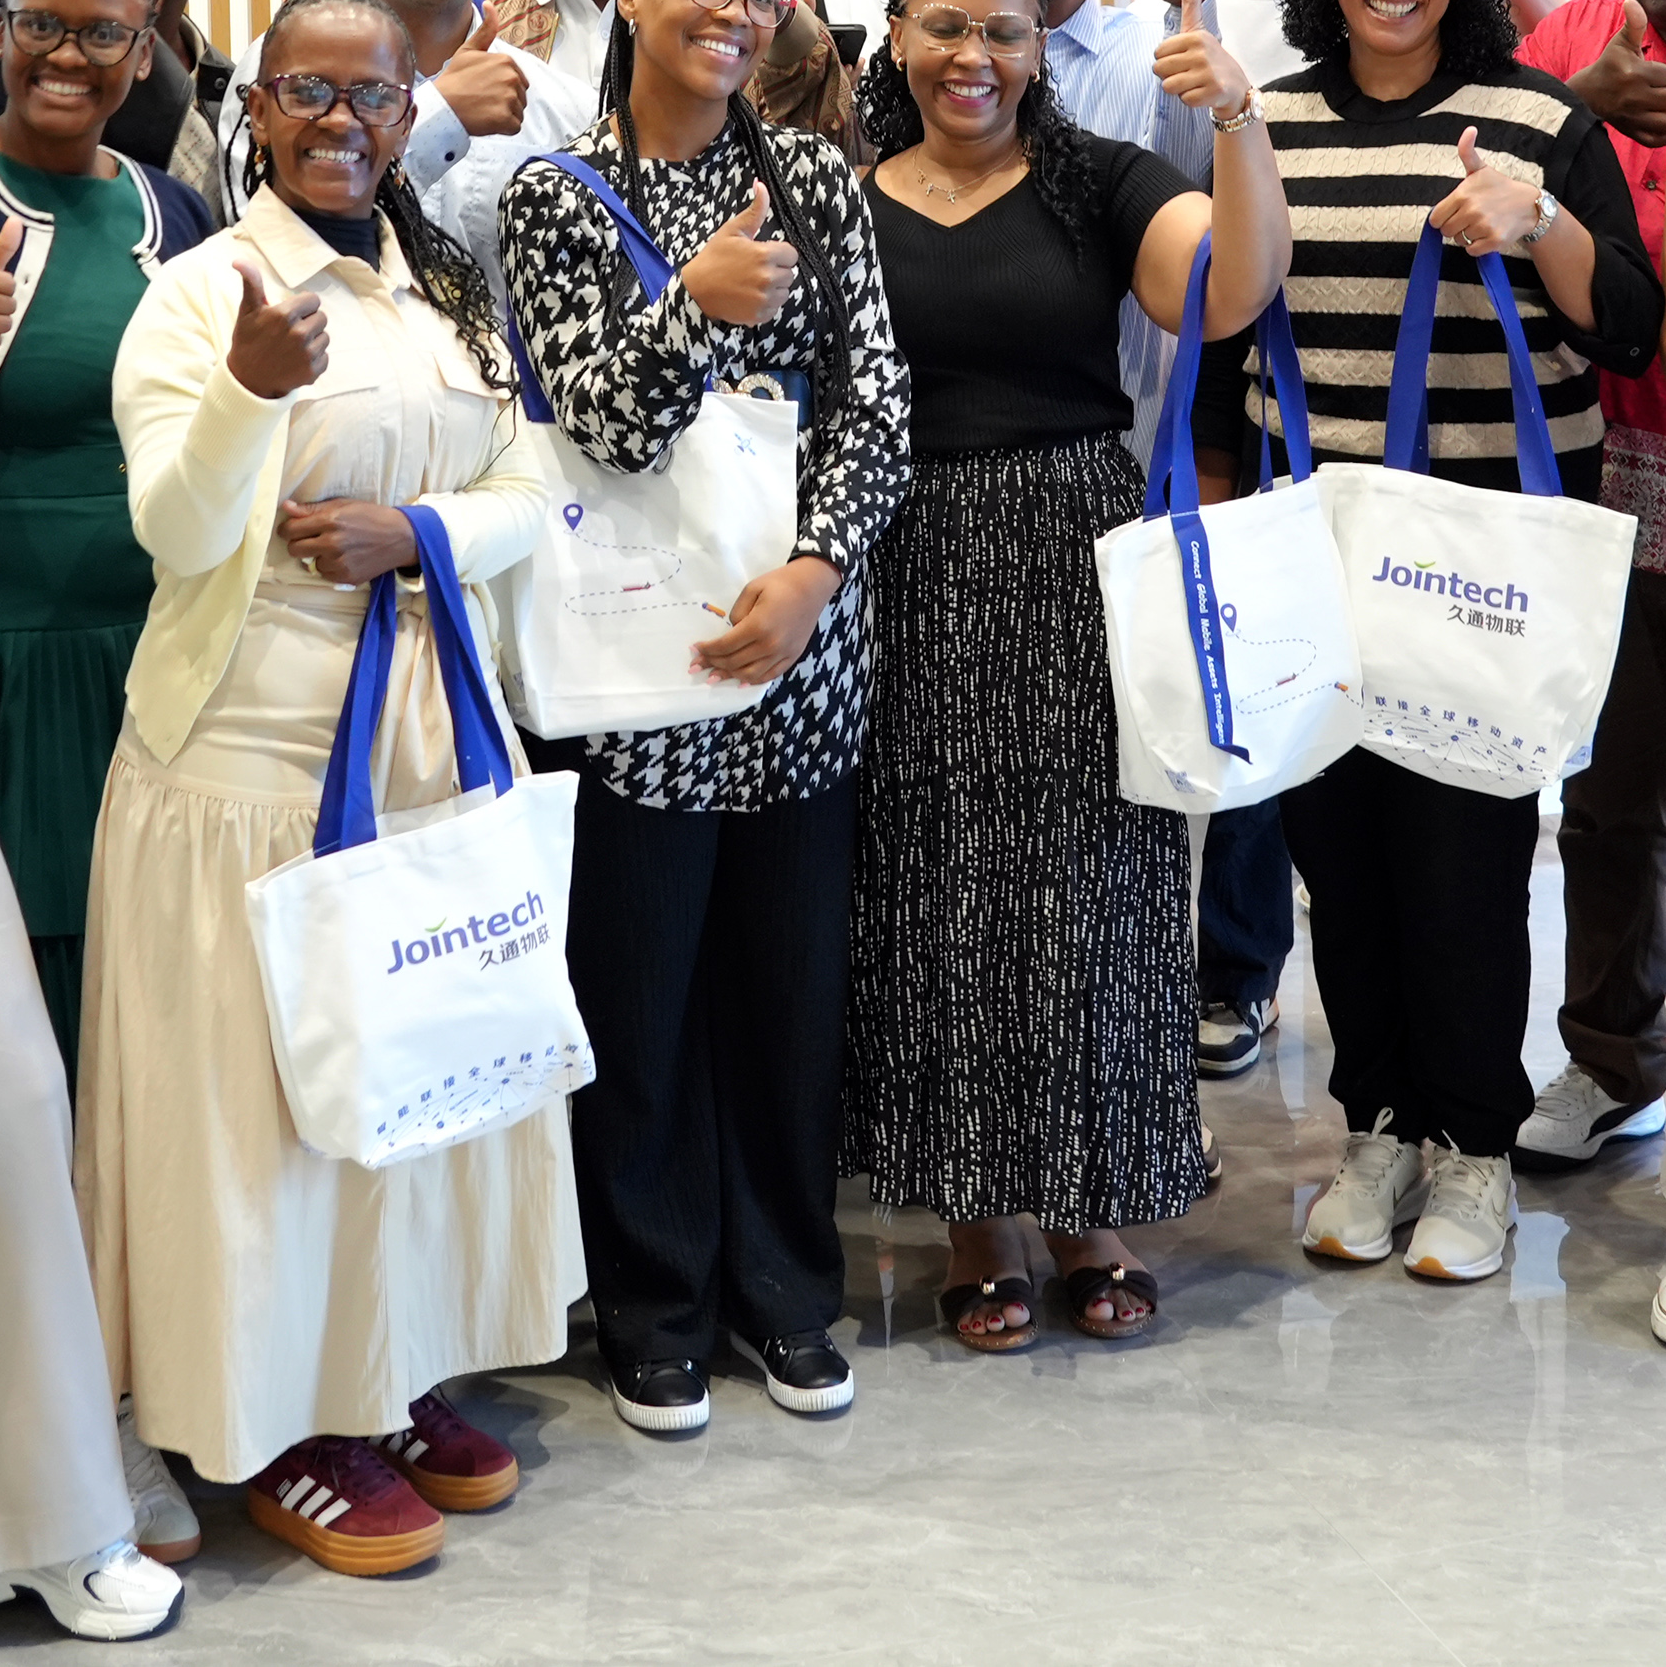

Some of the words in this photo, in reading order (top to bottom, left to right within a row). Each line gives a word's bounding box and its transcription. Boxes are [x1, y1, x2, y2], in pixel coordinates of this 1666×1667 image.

[1190, 540, 1202, 580] Connect
[1196, 583, 1208, 614] Global
[1372, 556, 1528, 613] Jointech
[1201, 618, 1213, 651] Mobile
[1447, 604, 1525, 637] 久通物联
[1206, 655, 1218, 689] Assets
[387, 890, 544, 974] Jointech
[479, 922, 551, 971] 久通物联
